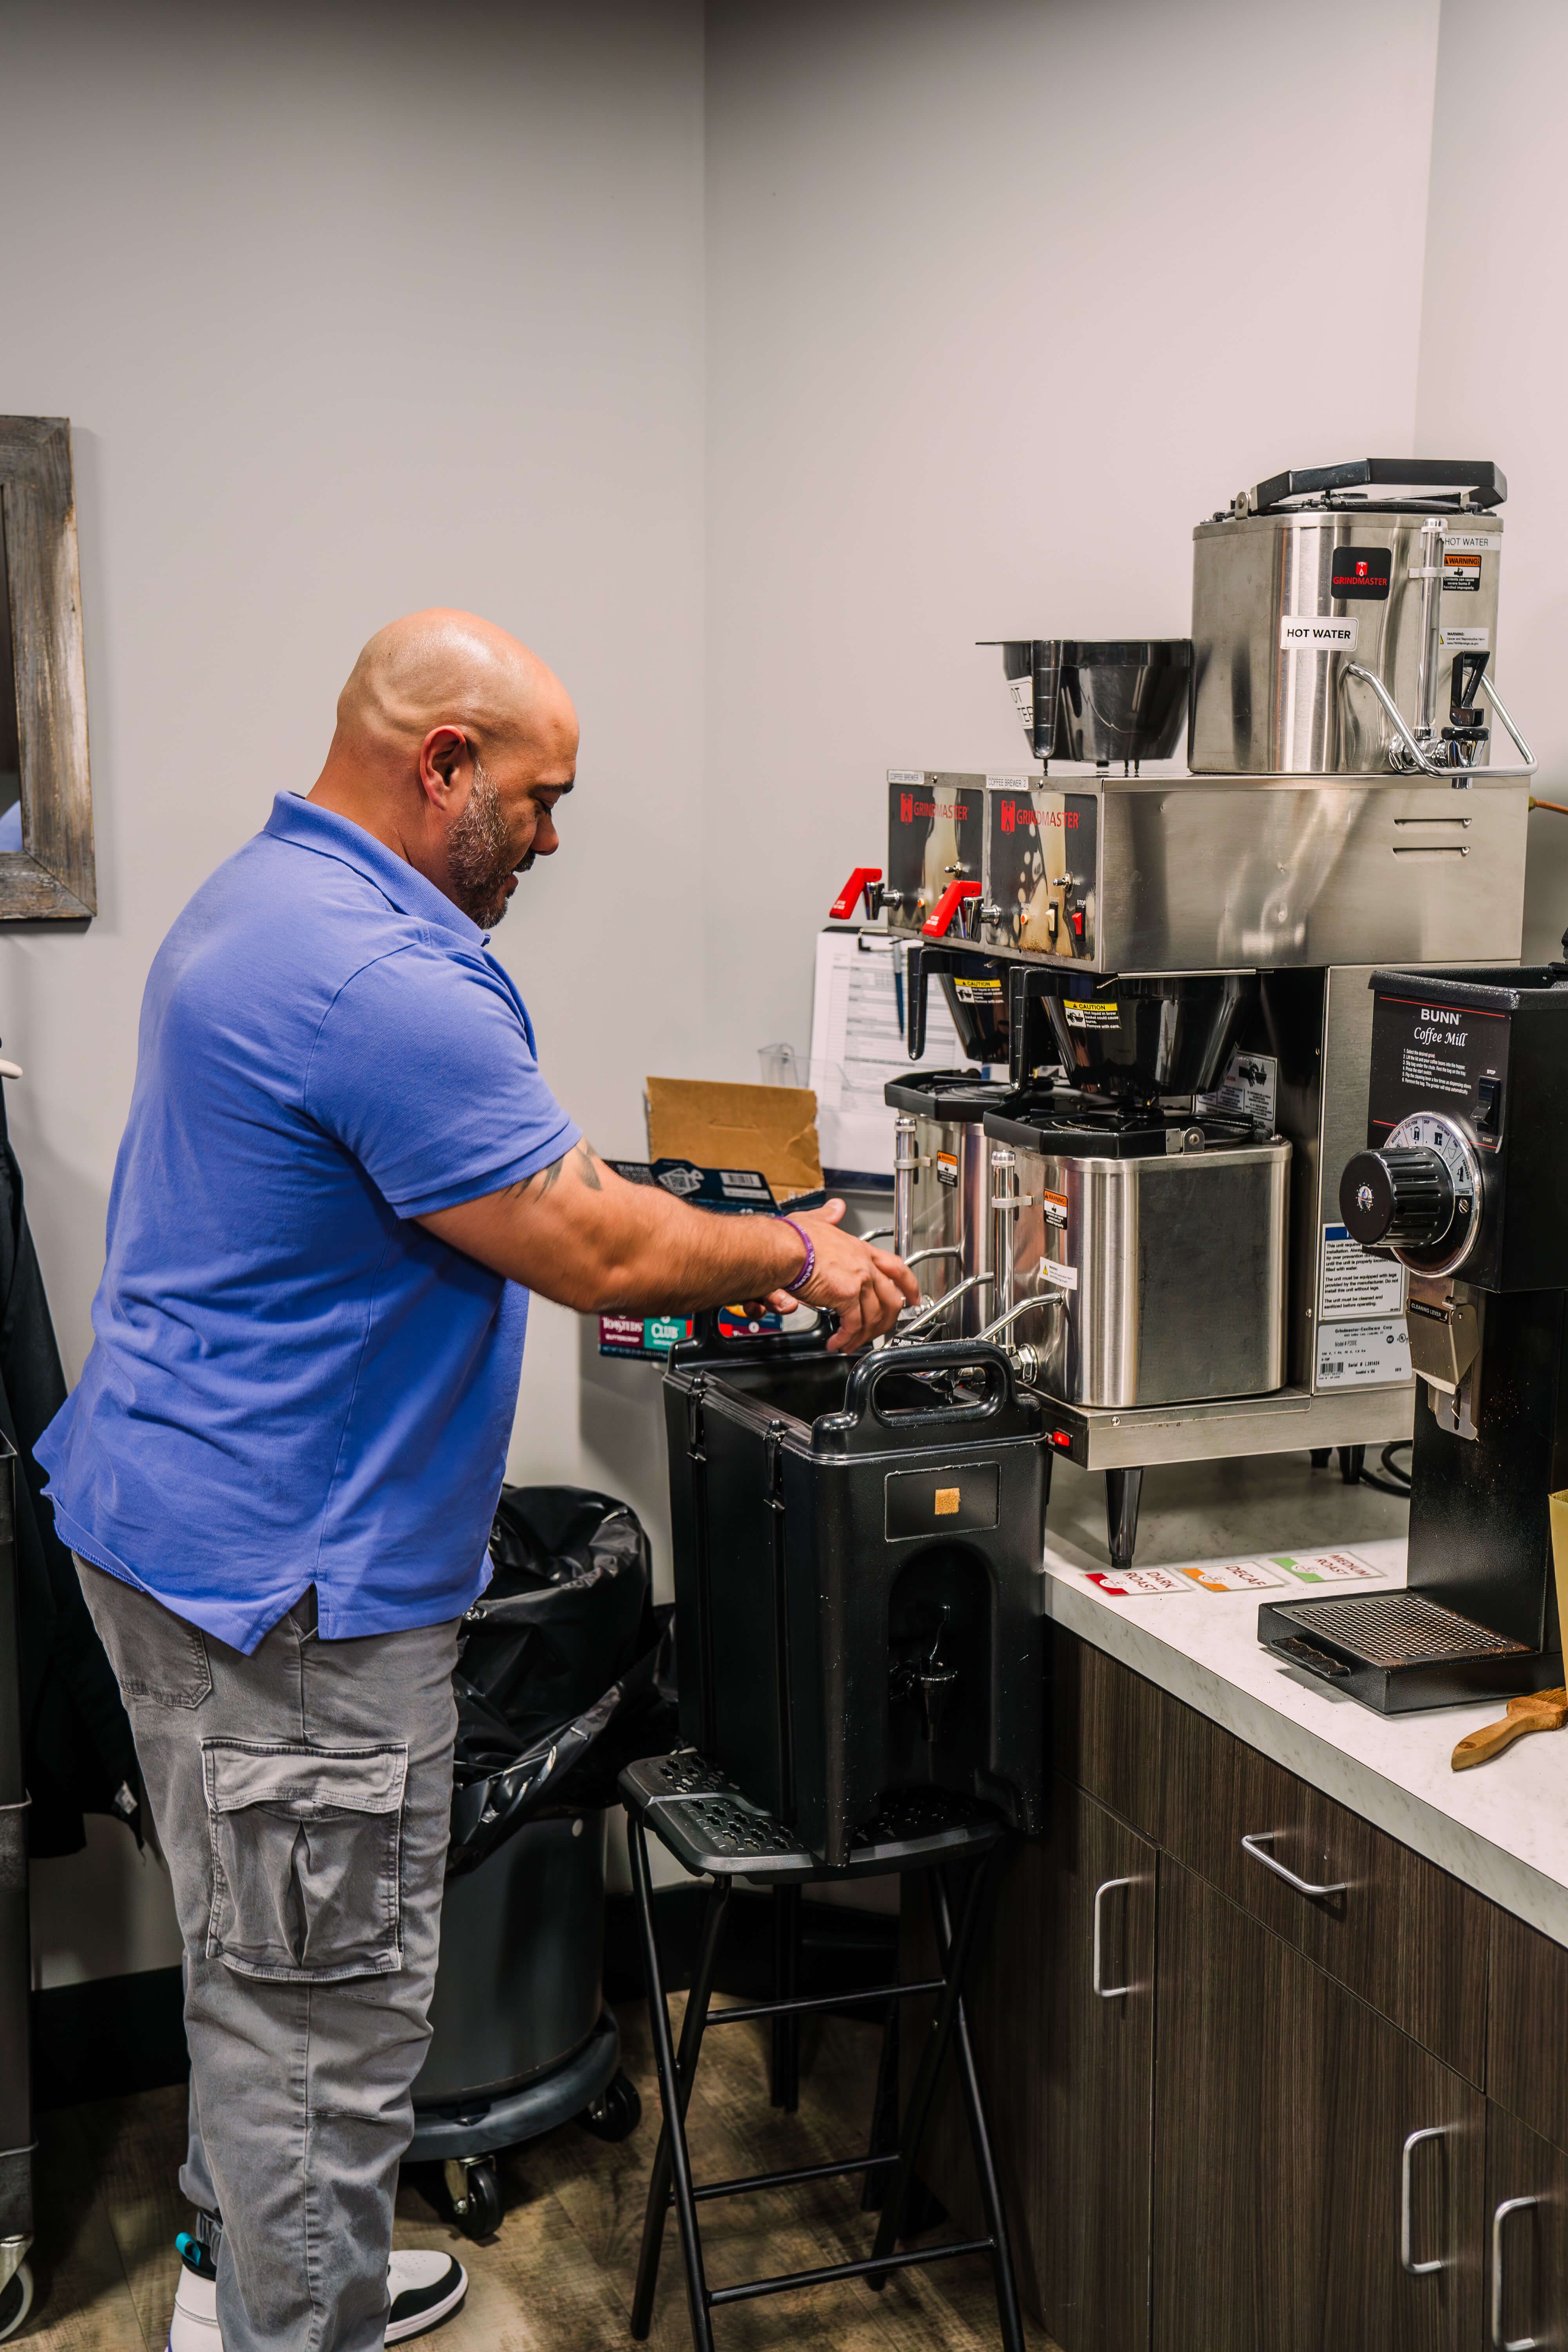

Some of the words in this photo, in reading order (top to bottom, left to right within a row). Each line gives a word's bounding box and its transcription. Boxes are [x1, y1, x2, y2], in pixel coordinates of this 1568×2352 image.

[1333, 577, 1387, 586] GRINDMASTER
[1287, 629, 1309, 637] HOT
[1313, 629, 1350, 639] WATER
[988, 778, 1004, 786] COFFEE
[1005, 778, 1021, 787] BREWER
[914, 802, 967, 820] GRINDMASTER
[1016, 809, 1078, 828] GRINDMASTER
[1421, 1008, 1459, 1025] BUNN
[1414, 1027, 1442, 1045] Coffee
[1444, 1032, 1468, 1047] Mill
[1391, 1131, 1401, 1143] REGULAR
[1437, 1124, 1450, 1136] AUTO-DRIP
[1049, 1194, 1065, 1204] WARNING
[1412, 1303, 1429, 1313] CLEANING
[651, 1323, 678, 1339] CLUB
[1314, 1559, 1350, 1575] ROAST
[1329, 1555, 1371, 1576] MEDIUM
[1123, 1572, 1158, 1591] ROAST
[1146, 1572, 1178, 1588] DARK
[1225, 1566, 1267, 1586] DECAF
